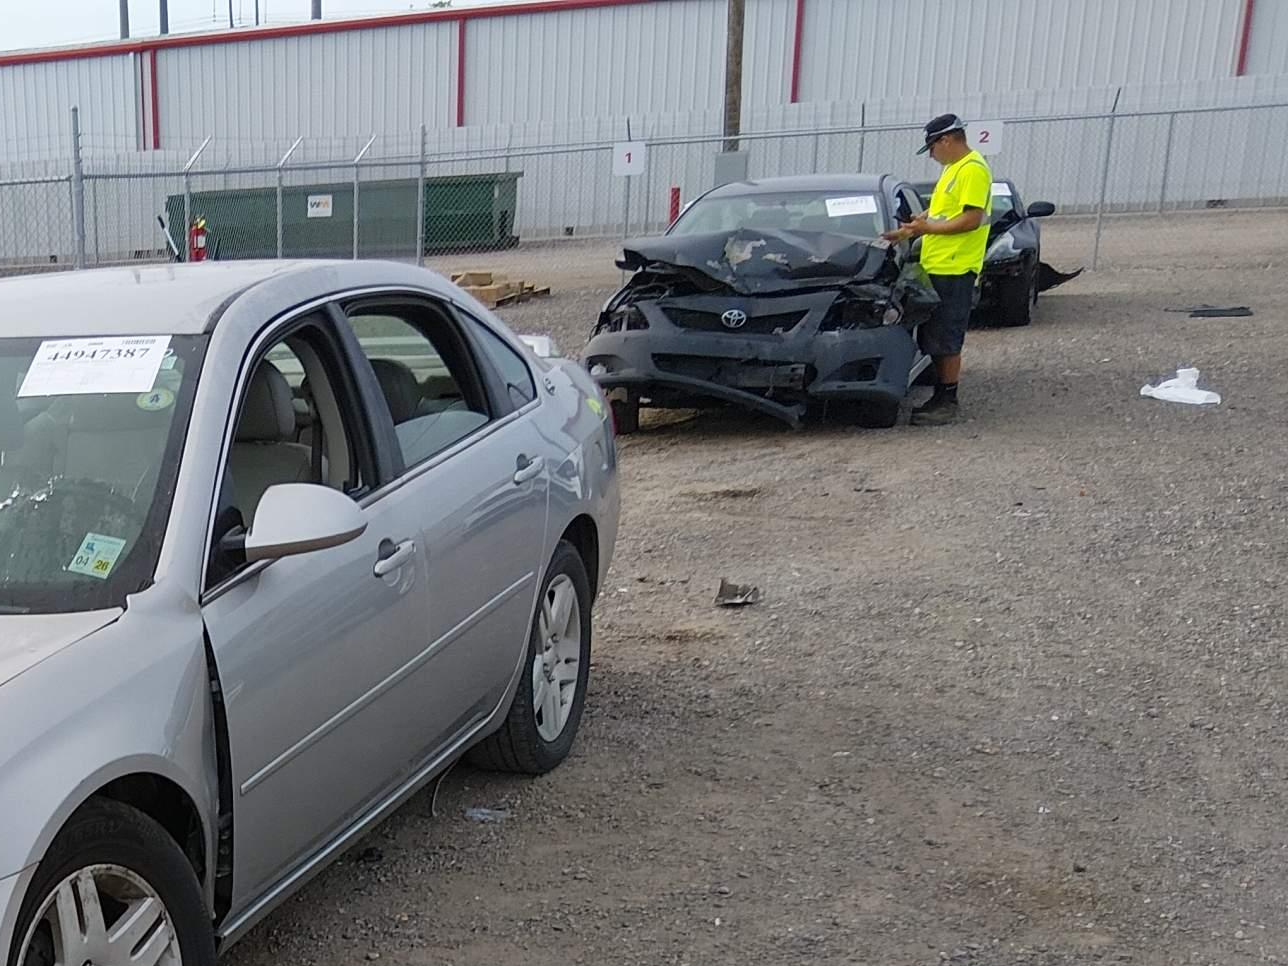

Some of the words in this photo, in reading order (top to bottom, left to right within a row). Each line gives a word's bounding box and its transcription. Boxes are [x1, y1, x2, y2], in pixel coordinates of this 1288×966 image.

[979, 130, 990, 144] 2
[625, 152, 632, 163] 1
[47, 347, 150, 361] 44947387
